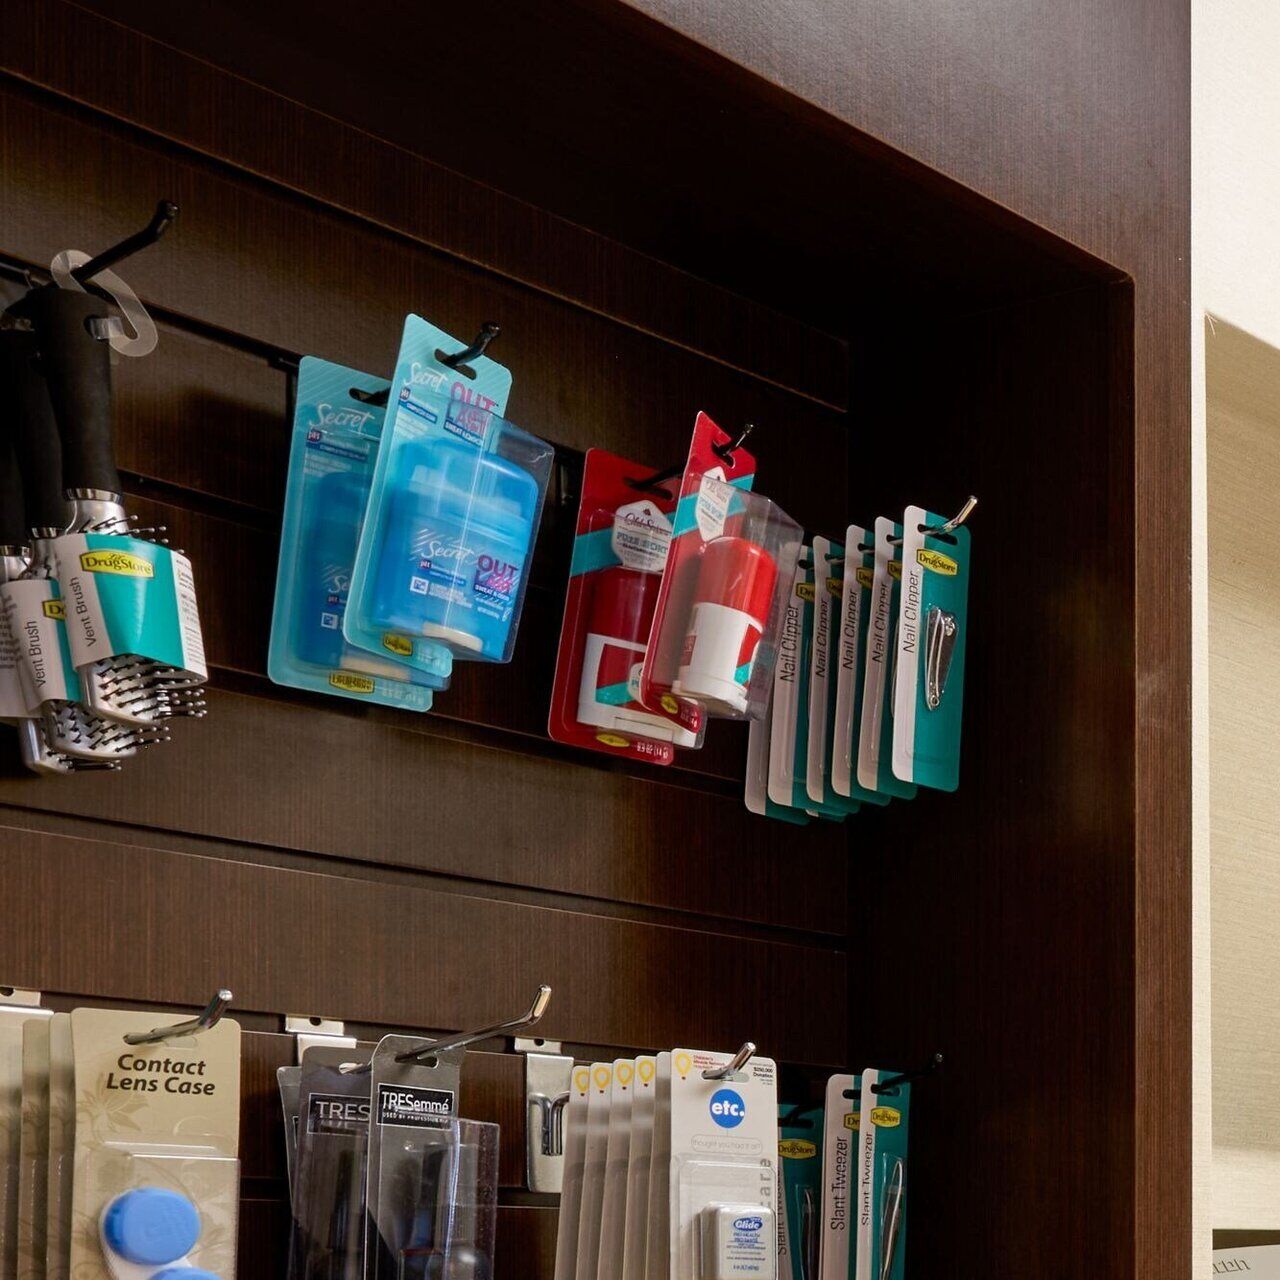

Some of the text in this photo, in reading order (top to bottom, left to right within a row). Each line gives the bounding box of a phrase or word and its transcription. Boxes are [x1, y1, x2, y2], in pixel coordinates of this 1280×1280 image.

[403, 362, 448, 392] Secret
[310, 403, 375, 432] Secret
[85, 557, 153, 573] DrugStore
[477, 555, 518, 577] OUT
[919, 552, 956, 574] DrugStore
[69, 576, 97, 647] Vent Brush
[872, 583, 890, 663] Nail Clipper
[903, 571, 921, 654] Nail Clipper
[780, 604, 800, 683] Nail Clipper
[815, 599, 831, 678] Nail Clipper
[843, 591, 859, 670] Nail Clipper
[24, 620, 46, 688] Vent Brush
[118, 1054, 206, 1076] Contact
[106, 1073, 216, 1095] Lens Case
[316, 1101, 371, 1121] TRES
[381, 1091, 450, 1115] TRESemmé
[711, 1100, 745, 1117] etc.
[831, 1137, 848, 1231] Slant Tweezer
[862, 1132, 873, 1226] Slant Tweezer
[734, 1220, 759, 1229] Glide
